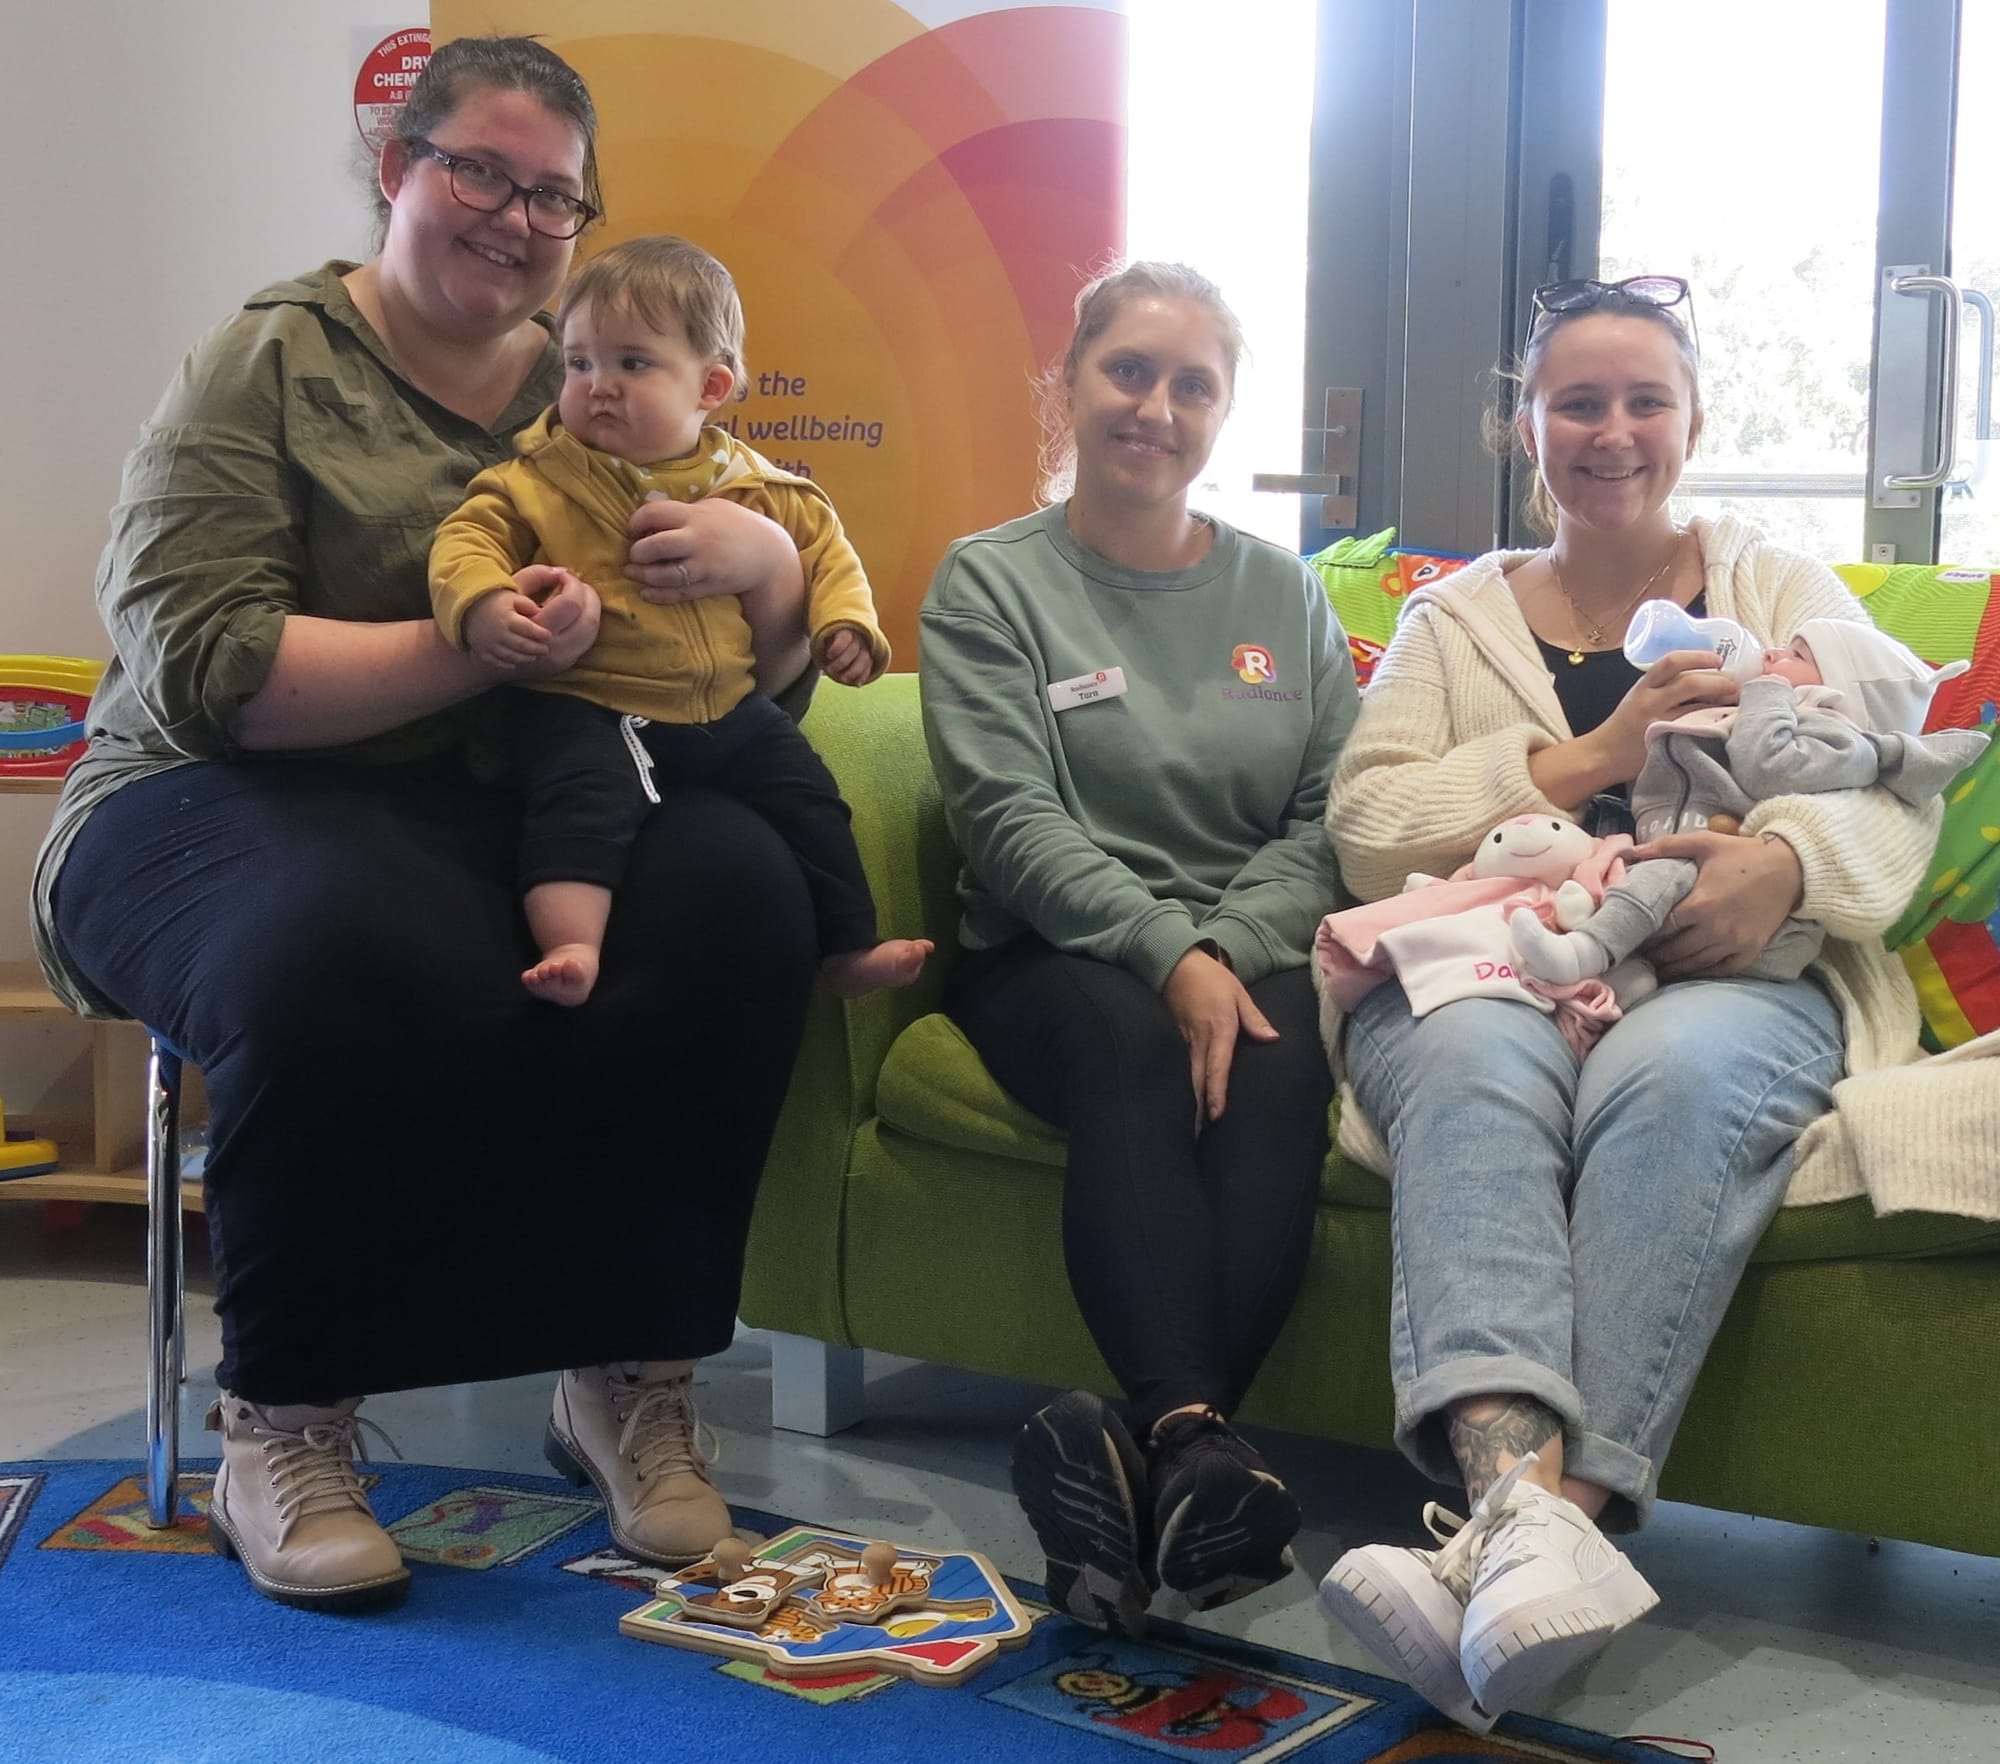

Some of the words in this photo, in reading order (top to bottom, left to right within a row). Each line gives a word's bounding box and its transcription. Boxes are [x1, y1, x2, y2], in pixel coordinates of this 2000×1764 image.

[377, 39, 397, 58] THIS
[401, 55, 431, 70] DRY
[373, 72, 421, 87] CHEM
[759, 371, 806, 396] the
[747, 414, 883, 448] wellbeing
[1243, 651, 1271, 677] R
[1078, 690, 1099, 700] Tara
[1222, 686, 1303, 702] Radiance
